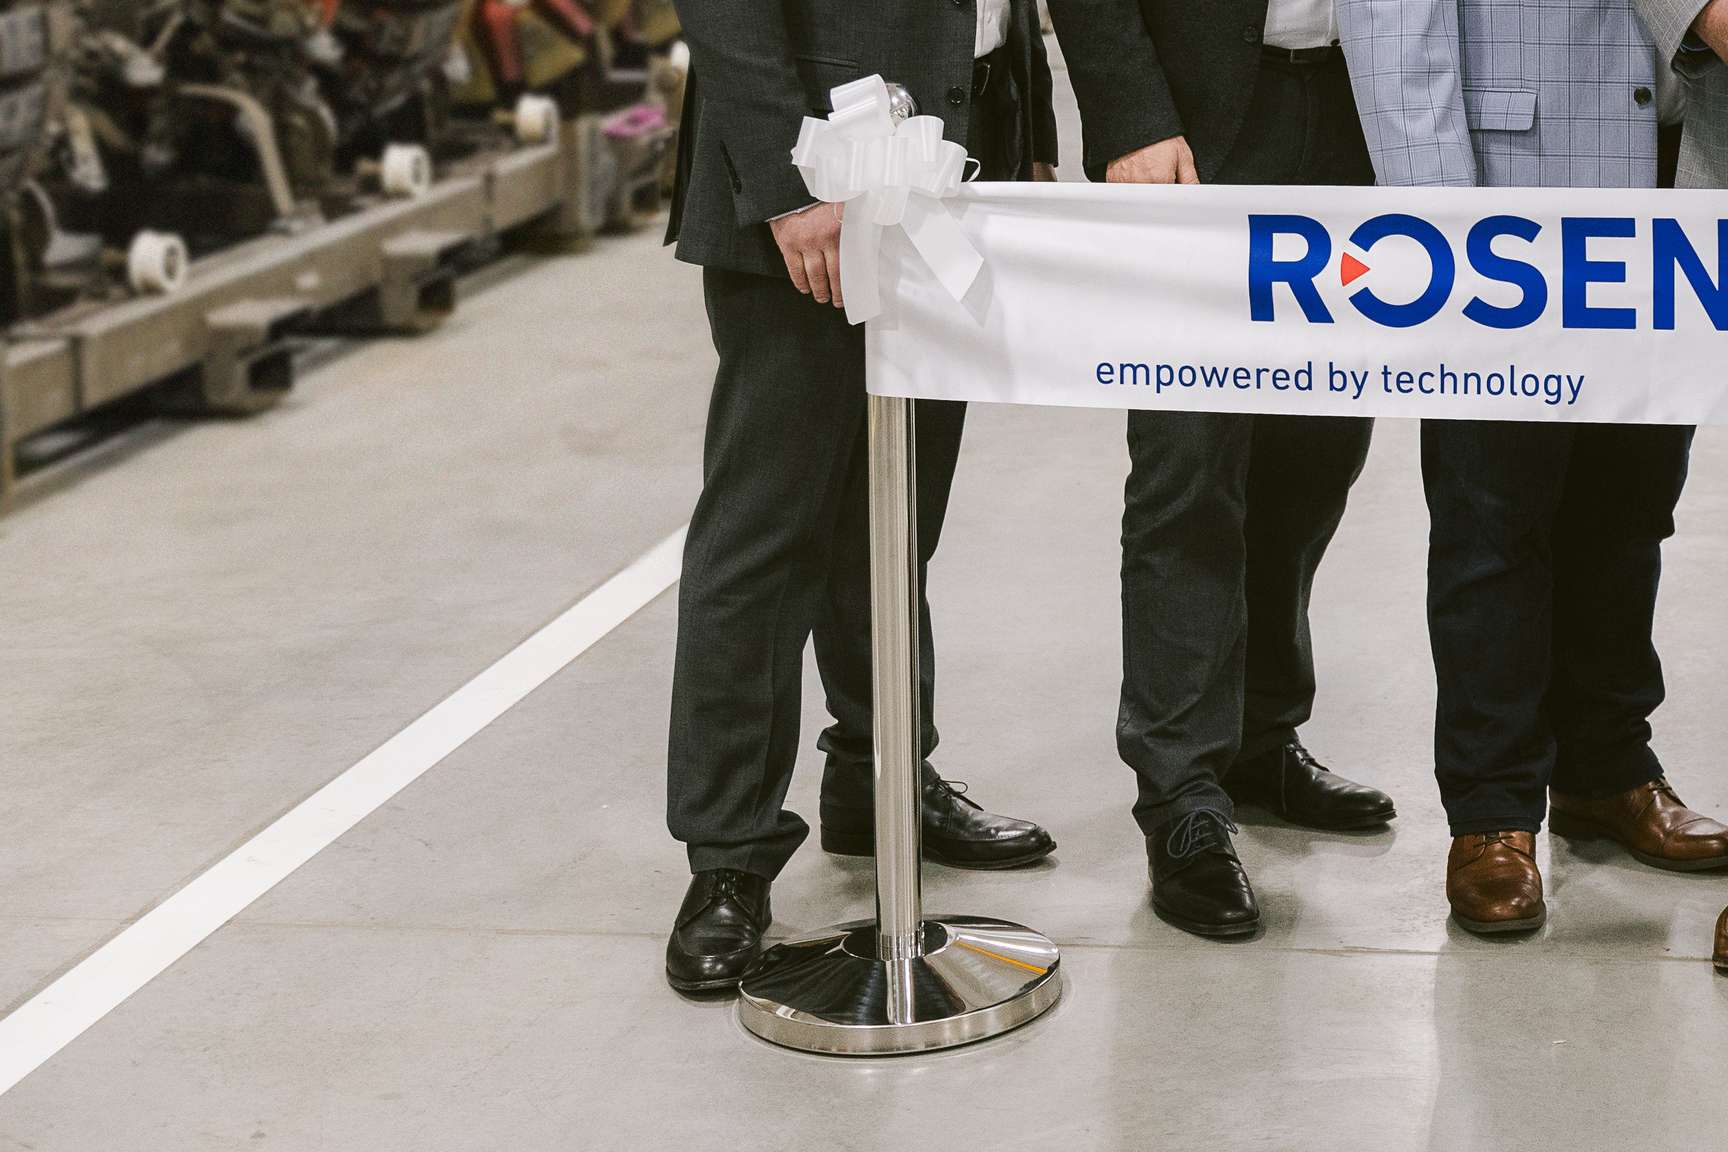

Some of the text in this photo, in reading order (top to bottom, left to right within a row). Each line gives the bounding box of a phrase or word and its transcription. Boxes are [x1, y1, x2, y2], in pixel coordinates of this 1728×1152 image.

[1096, 360, 1585, 405] empowered by technology
